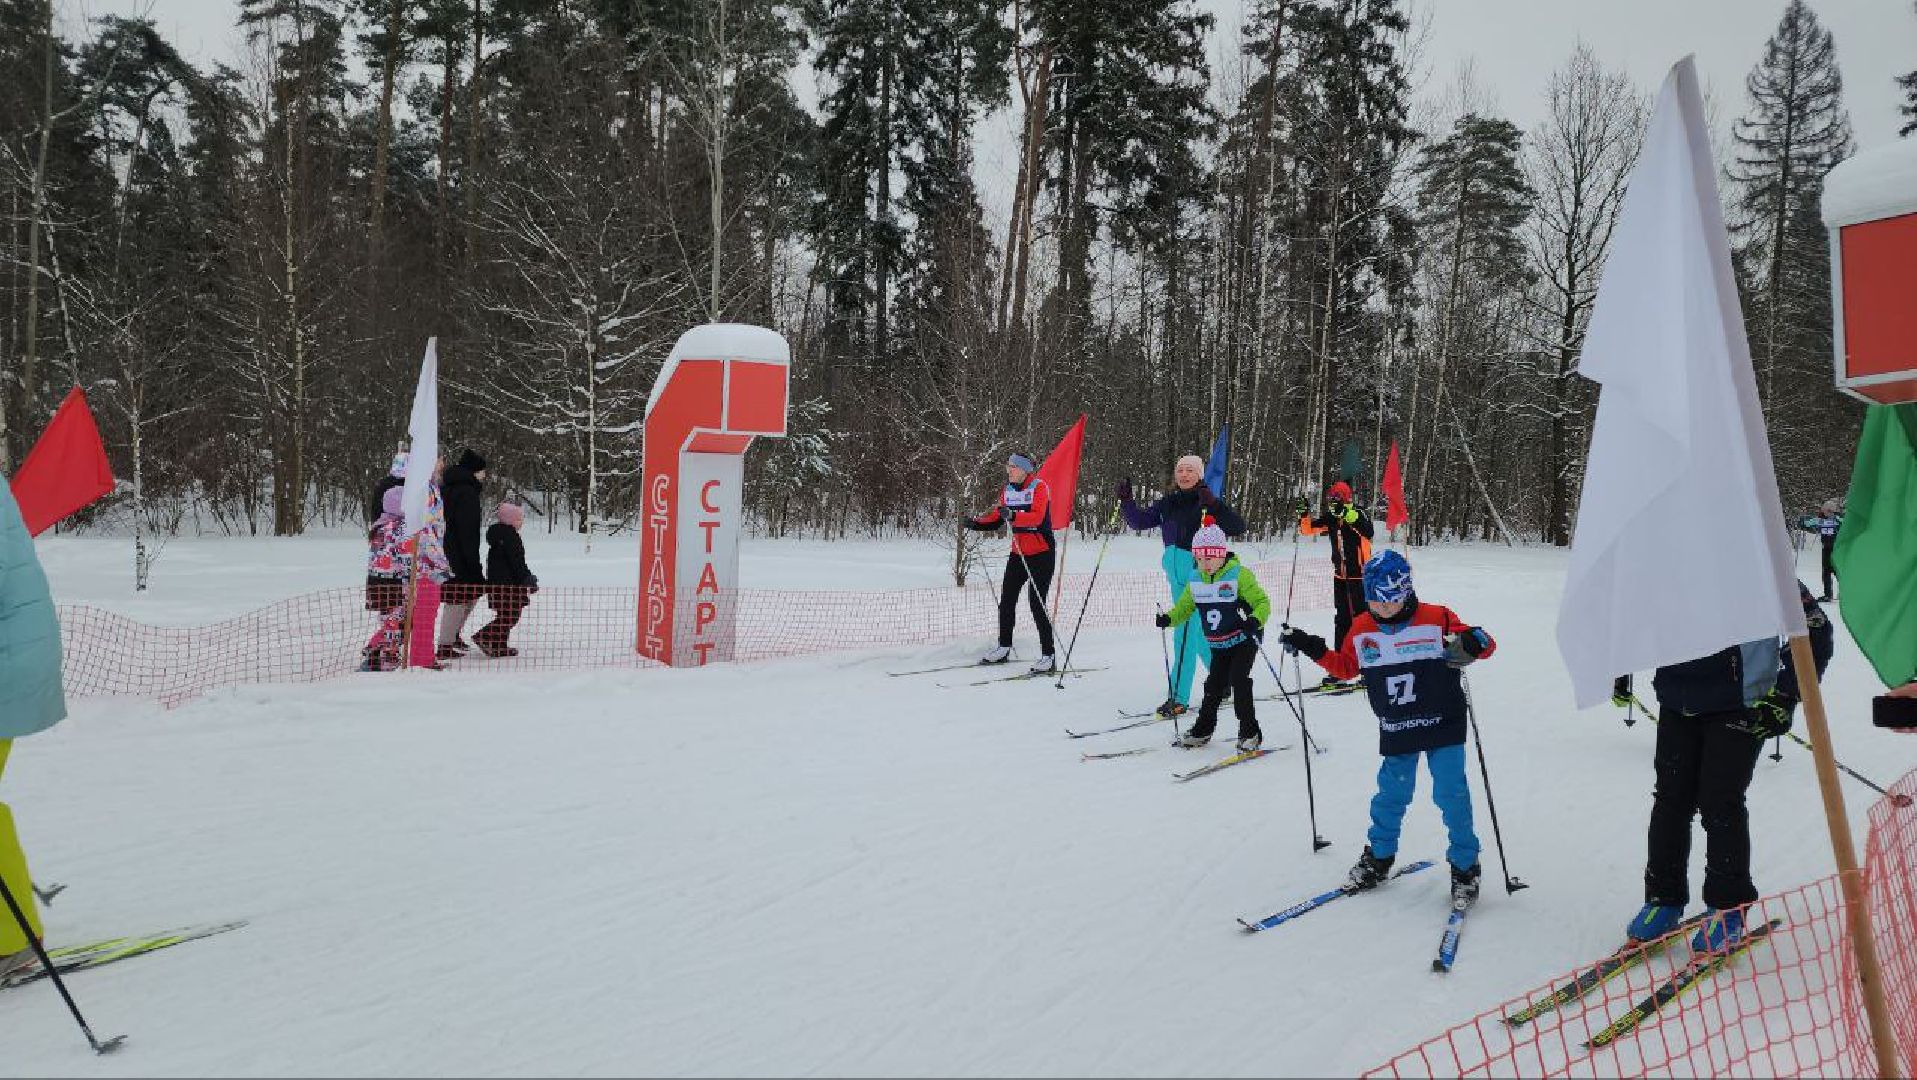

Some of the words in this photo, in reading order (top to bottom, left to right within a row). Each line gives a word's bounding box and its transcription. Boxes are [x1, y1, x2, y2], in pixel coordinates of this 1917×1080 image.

[645, 473, 670, 661] СТАРТ
[693, 479, 721, 666] СТАРТ
[1206, 609, 1222, 631] 9
